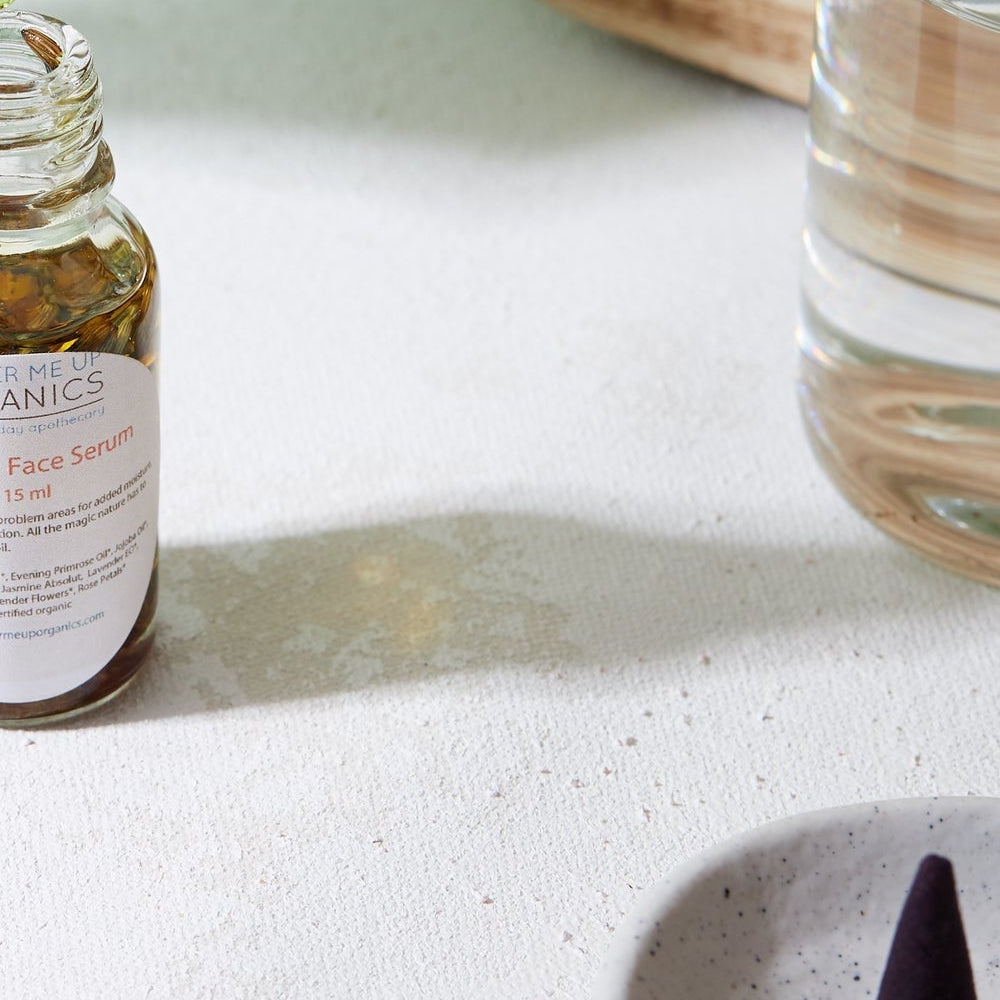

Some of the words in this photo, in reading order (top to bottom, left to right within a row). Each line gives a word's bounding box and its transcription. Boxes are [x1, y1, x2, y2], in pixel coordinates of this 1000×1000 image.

[29, 360, 63, 382] ME
[72, 352, 100, 372] UP
[28, 405, 105, 435] apothecary
[8, 455, 64, 476] Face
[71, 424, 135, 466] Serum
[4, 488, 24, 502] 15
[29, 484, 52, 501] ml
[47, 506, 76, 520] areas
[78, 501, 92, 513] for
[94, 484, 122, 507] added
[27, 527, 41, 538] All
[44, 523, 62, 535] the
[65, 513, 96, 530] magic
[98, 498, 126, 519] nature
[127, 488, 140, 502] has
[1, 583, 42, 594] Jasmine
[87, 554, 125, 578] Lavender
[10, 569, 51, 581] Evening
[54, 557, 95, 576] Primrose
[77, 580, 99, 593] Rose
[35, 600, 73, 616] organic
